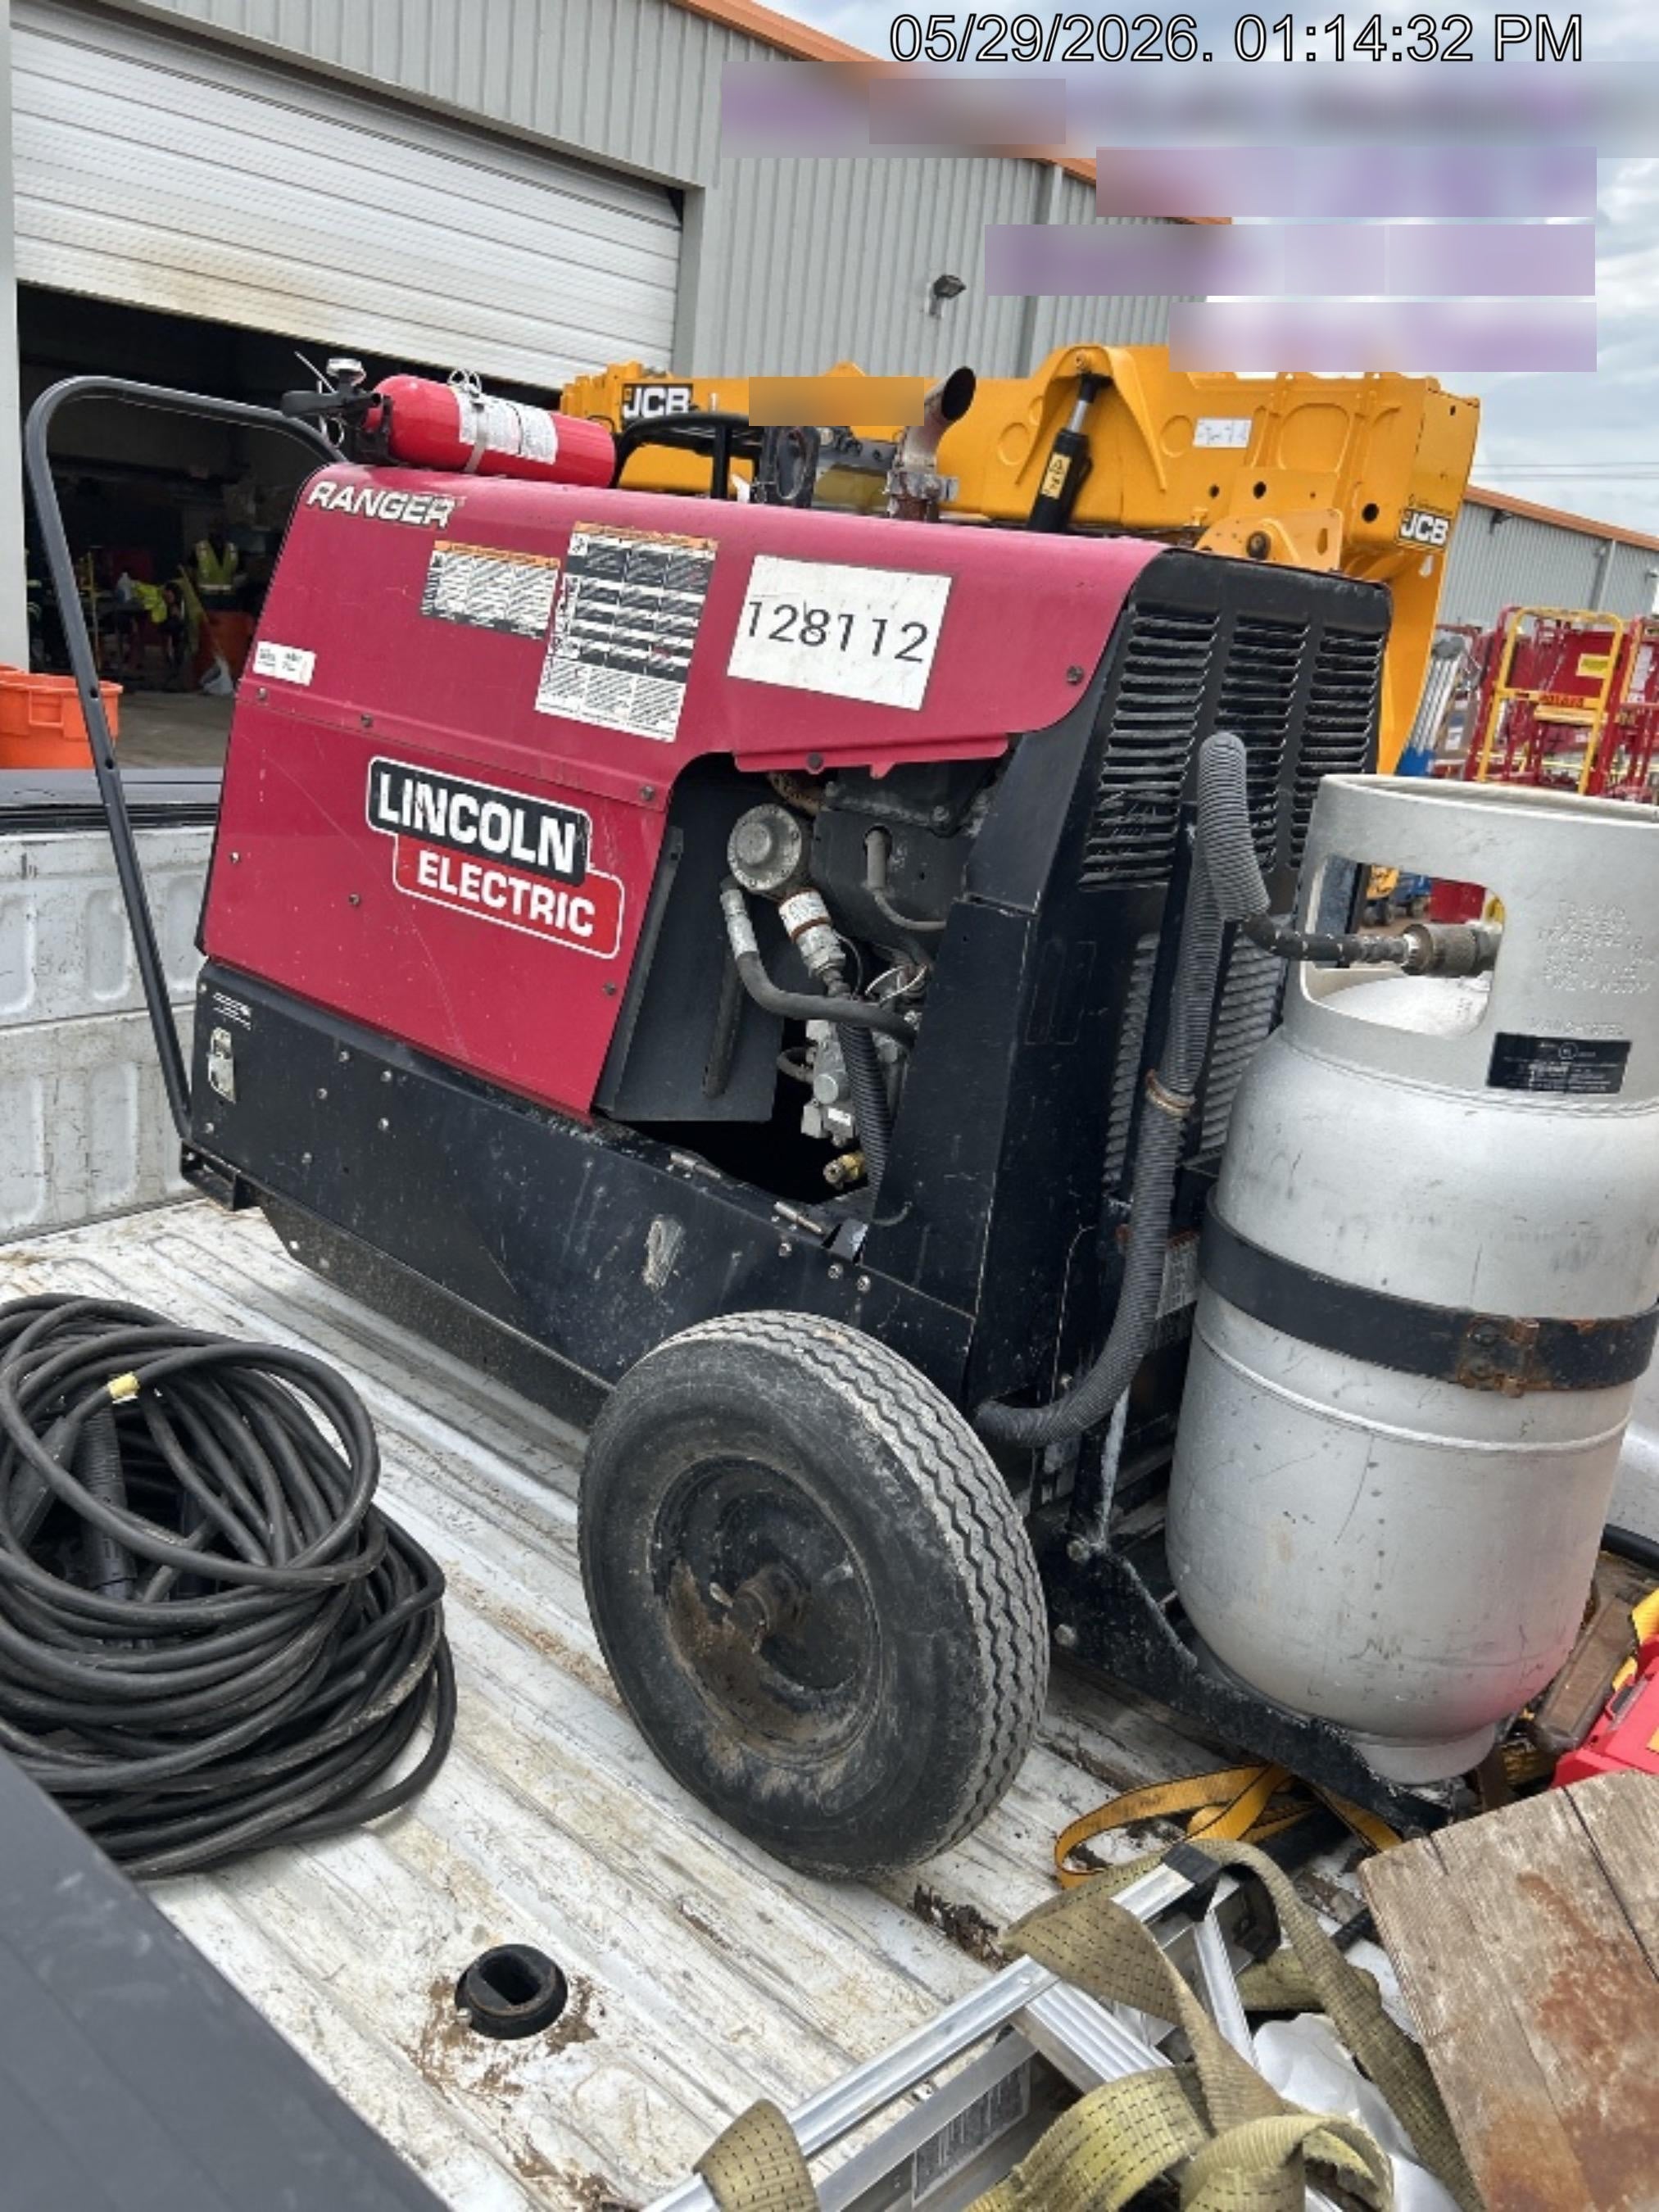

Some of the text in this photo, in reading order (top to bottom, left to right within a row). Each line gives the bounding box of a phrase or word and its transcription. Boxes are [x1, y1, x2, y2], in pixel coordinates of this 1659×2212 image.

[623, 387, 690, 419] JCB
[307, 481, 456, 528] RANGER
[1400, 512, 1449, 545] JCB
[748, 601, 929, 664] 128112
[377, 773, 577, 874] LINCOLN
[417, 850, 596, 938] ELECTRIC
